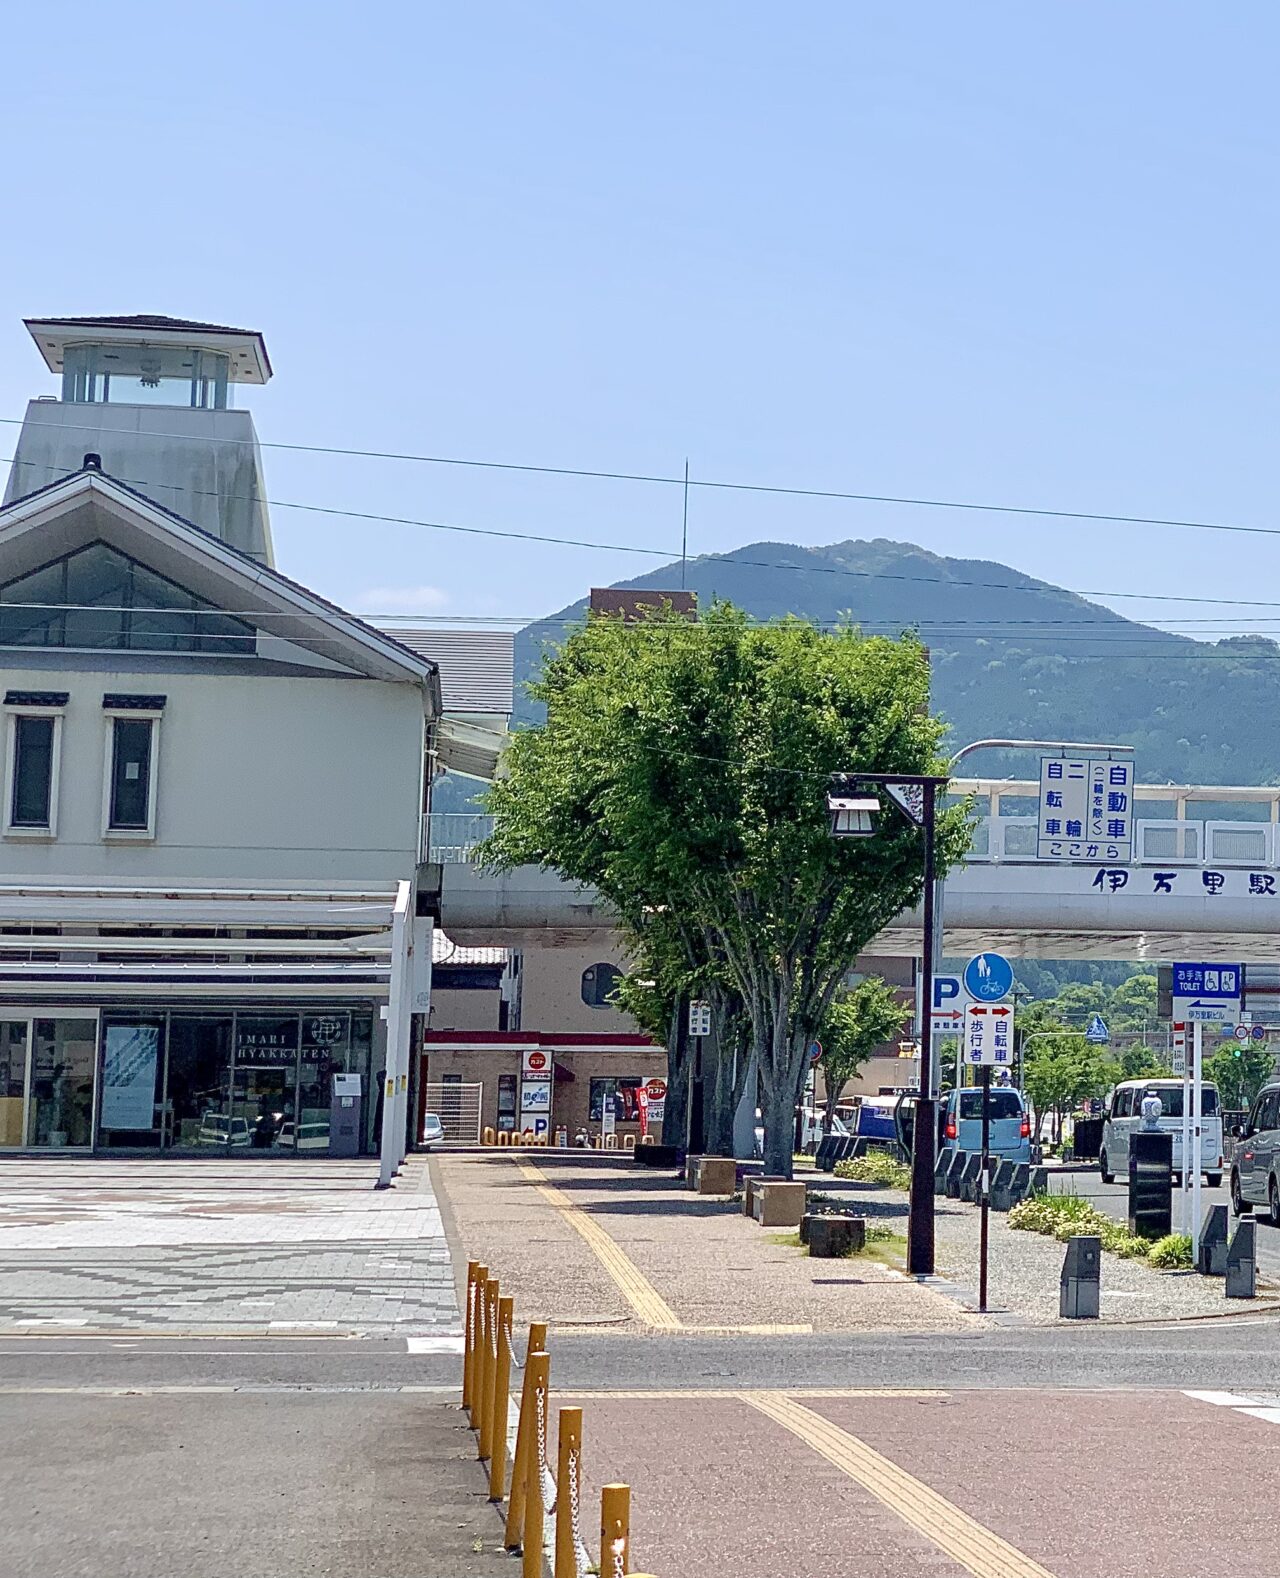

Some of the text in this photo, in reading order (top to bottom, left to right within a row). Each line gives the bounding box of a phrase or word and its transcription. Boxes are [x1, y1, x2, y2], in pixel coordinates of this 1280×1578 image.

[1045, 762, 1062, 835] 自転車
[1065, 764, 1084, 837] 二輪
[1106, 765, 1127, 839] 自動車
[1050, 843, 1119, 858] ここから
[1092, 868, 1277, 895] 伊万里駅
[1178, 970, 1202, 981] お手洗
[1180, 982, 1200, 991] TOILET
[934, 978, 960, 1007] P
[1188, 1010, 1225, 1020] 伊万里駅ビル
[239, 1035, 285, 1043] IMARI
[970, 1020, 983, 1062] 歩行者
[995, 1021, 1007, 1062] 自転車
[238, 1049, 329, 1058] HYAKKATEN
[535, 1119, 547, 1136] P
